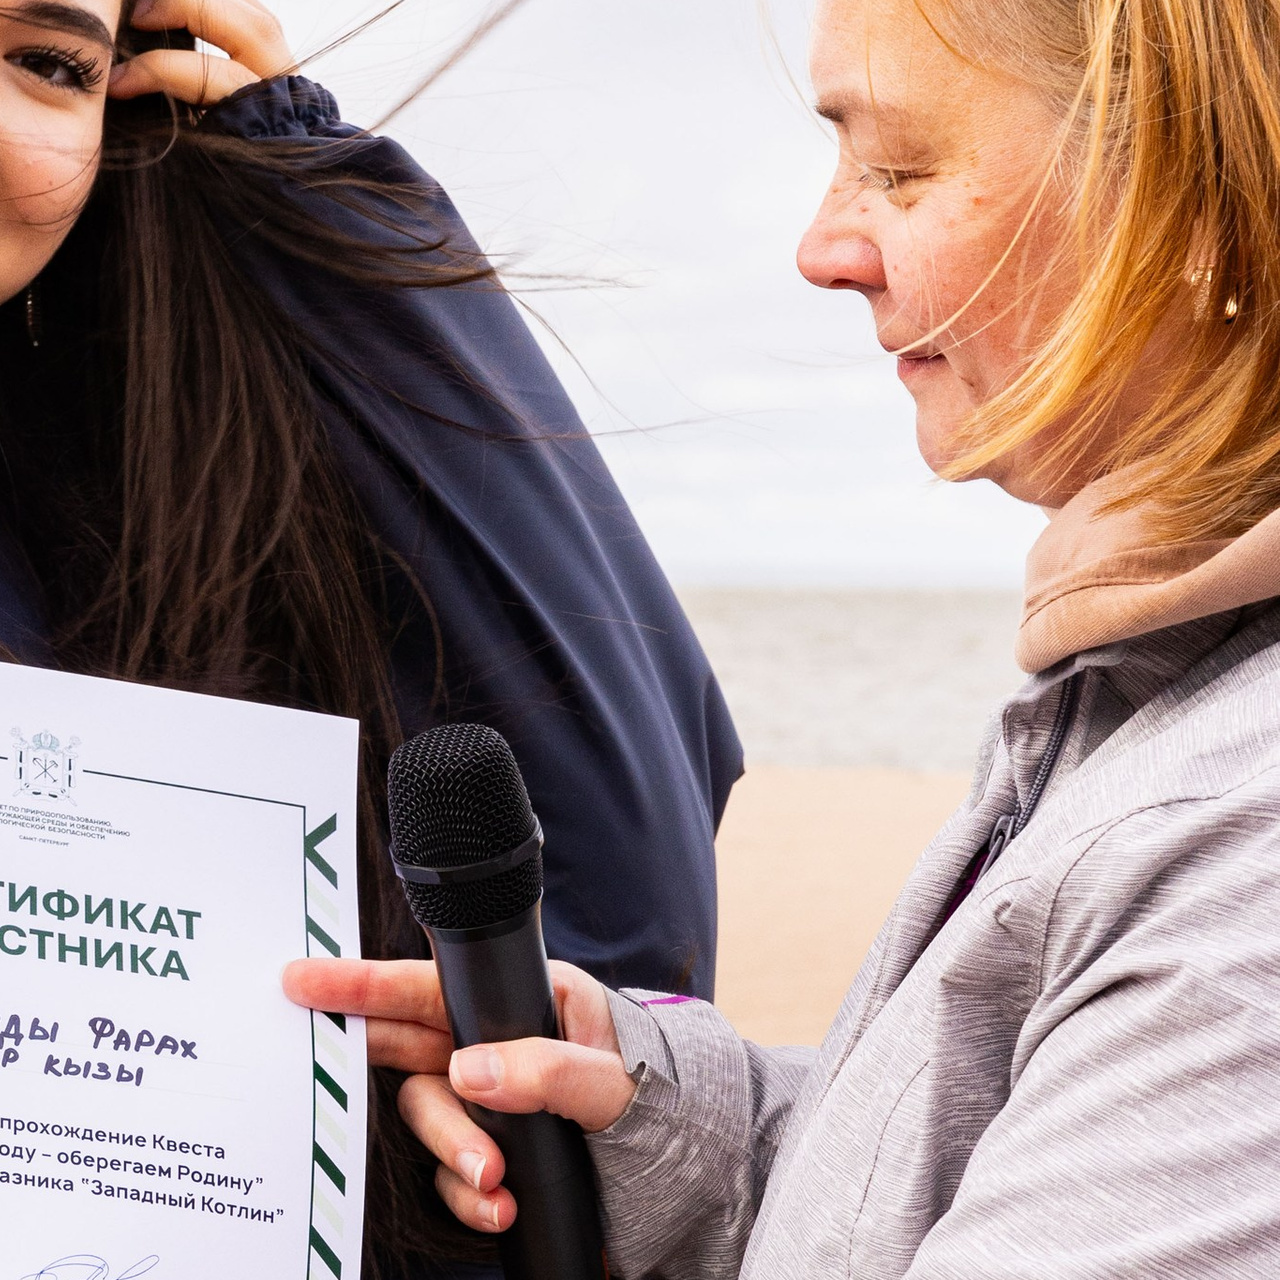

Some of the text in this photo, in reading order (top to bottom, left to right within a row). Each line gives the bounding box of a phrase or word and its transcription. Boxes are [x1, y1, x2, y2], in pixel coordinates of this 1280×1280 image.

[9, 805, 20, 813] ПО
[41, 817, 67, 828] СРЕДЫ
[75, 823, 131, 838] ОБЕСПЕЧЕНИЮ
[48, 826, 106, 841] БЕЗОПАСНОСТИ
[0, 1116, 147, 1147] прохождение
[152, 1133, 226, 1160] Квеста
[57, 1149, 172, 1179] оберегаем
